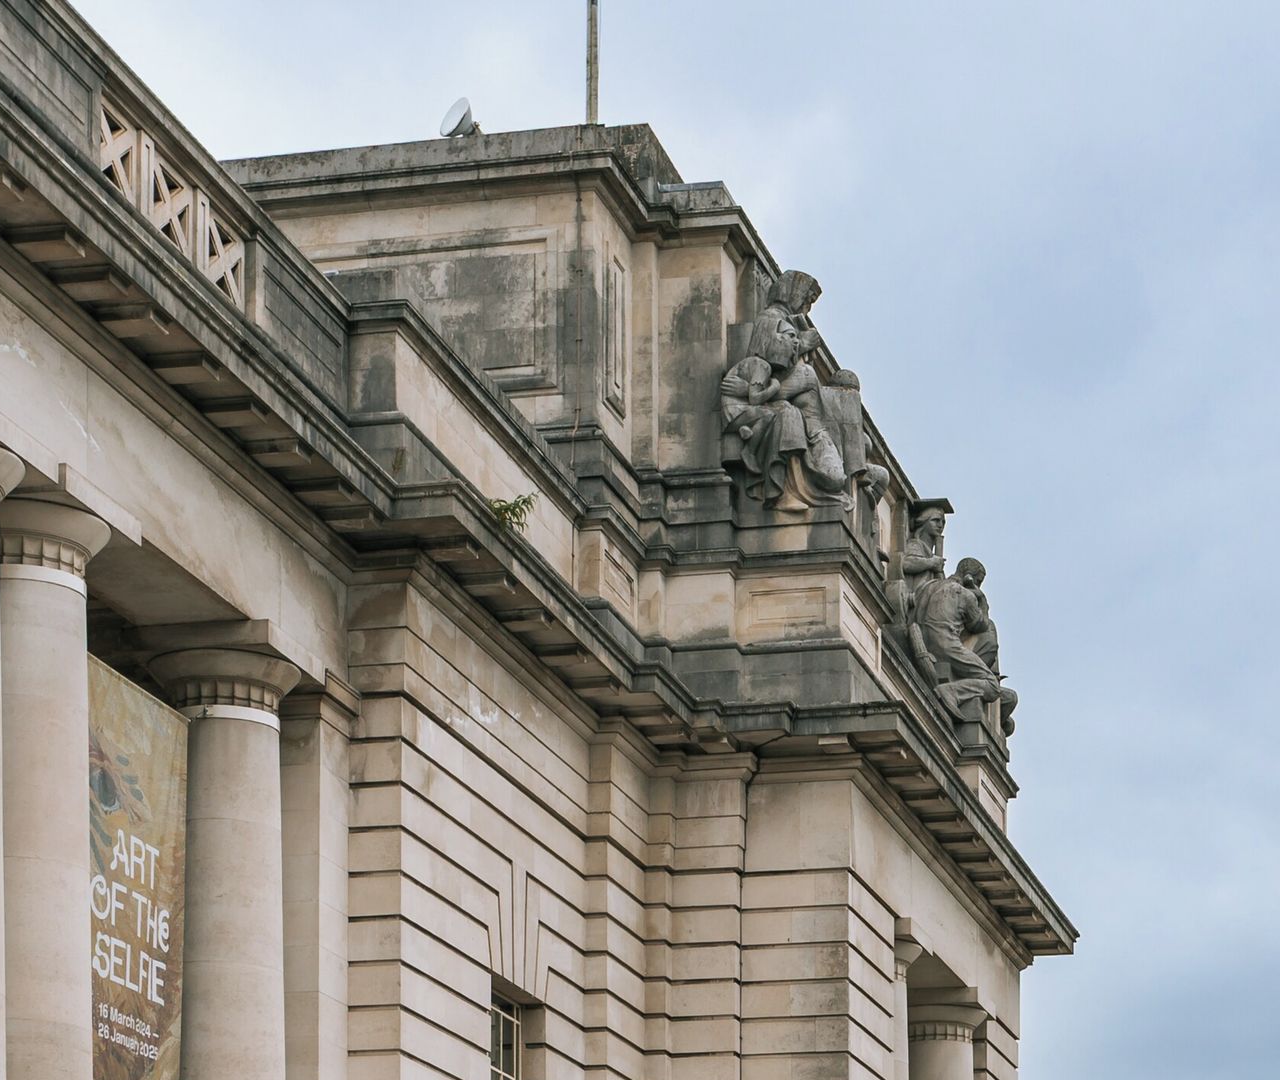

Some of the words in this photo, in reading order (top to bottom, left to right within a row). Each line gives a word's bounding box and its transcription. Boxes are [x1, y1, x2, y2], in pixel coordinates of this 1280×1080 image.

[110, 828, 159, 890] ART
[90, 874, 127, 927] OF
[92, 930, 166, 1007] SELFIE
[98, 1022, 110, 1039] 26
[139, 1041, 159, 1061] 2025
[99, 1002, 109, 1018] 16
[110, 1006, 135, 1030] March
